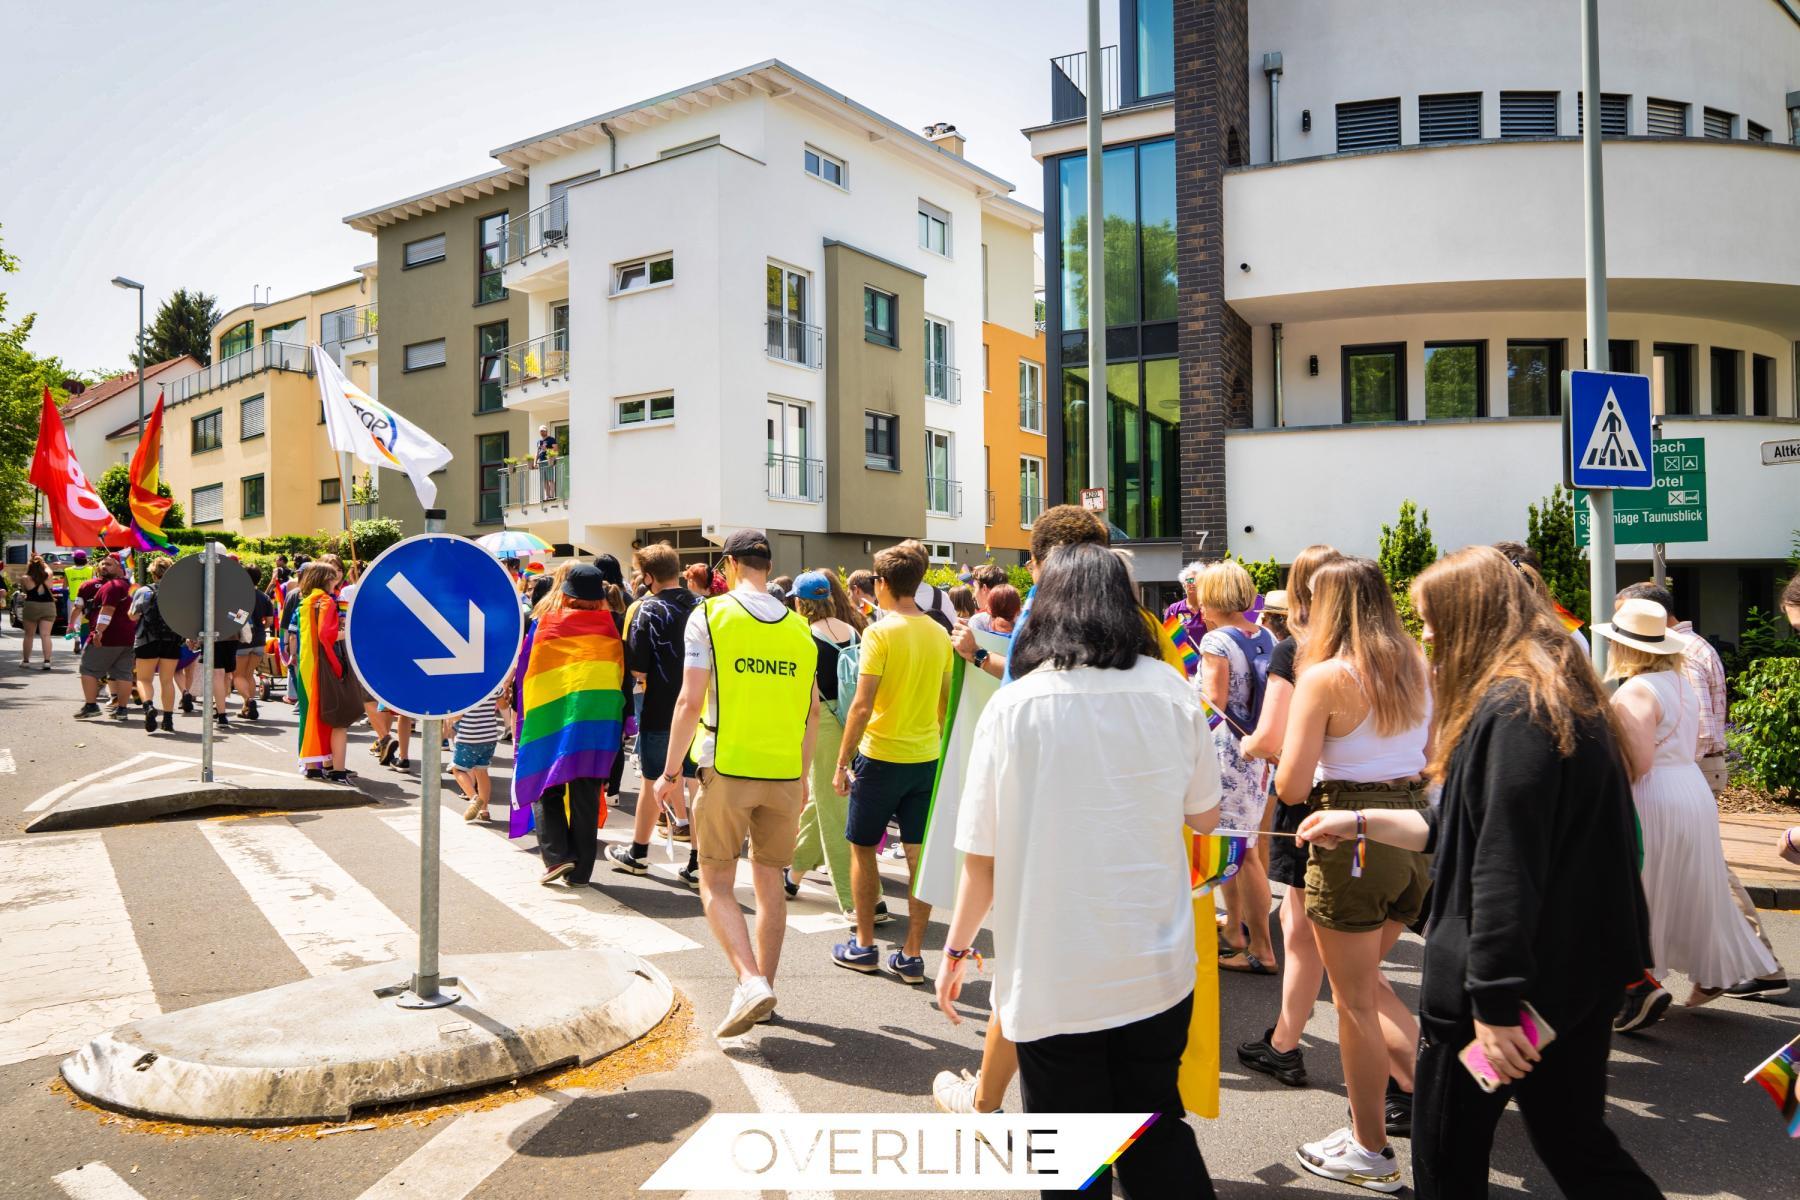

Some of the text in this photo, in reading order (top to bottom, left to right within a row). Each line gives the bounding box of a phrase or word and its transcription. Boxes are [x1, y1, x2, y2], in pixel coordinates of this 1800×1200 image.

[1652, 440, 1686, 453] bach
[1580, 509, 1703, 527] Spnlage Taunusblick
[1196, 530, 1209, 550] 7
[734, 657, 797, 677] ORDNER
